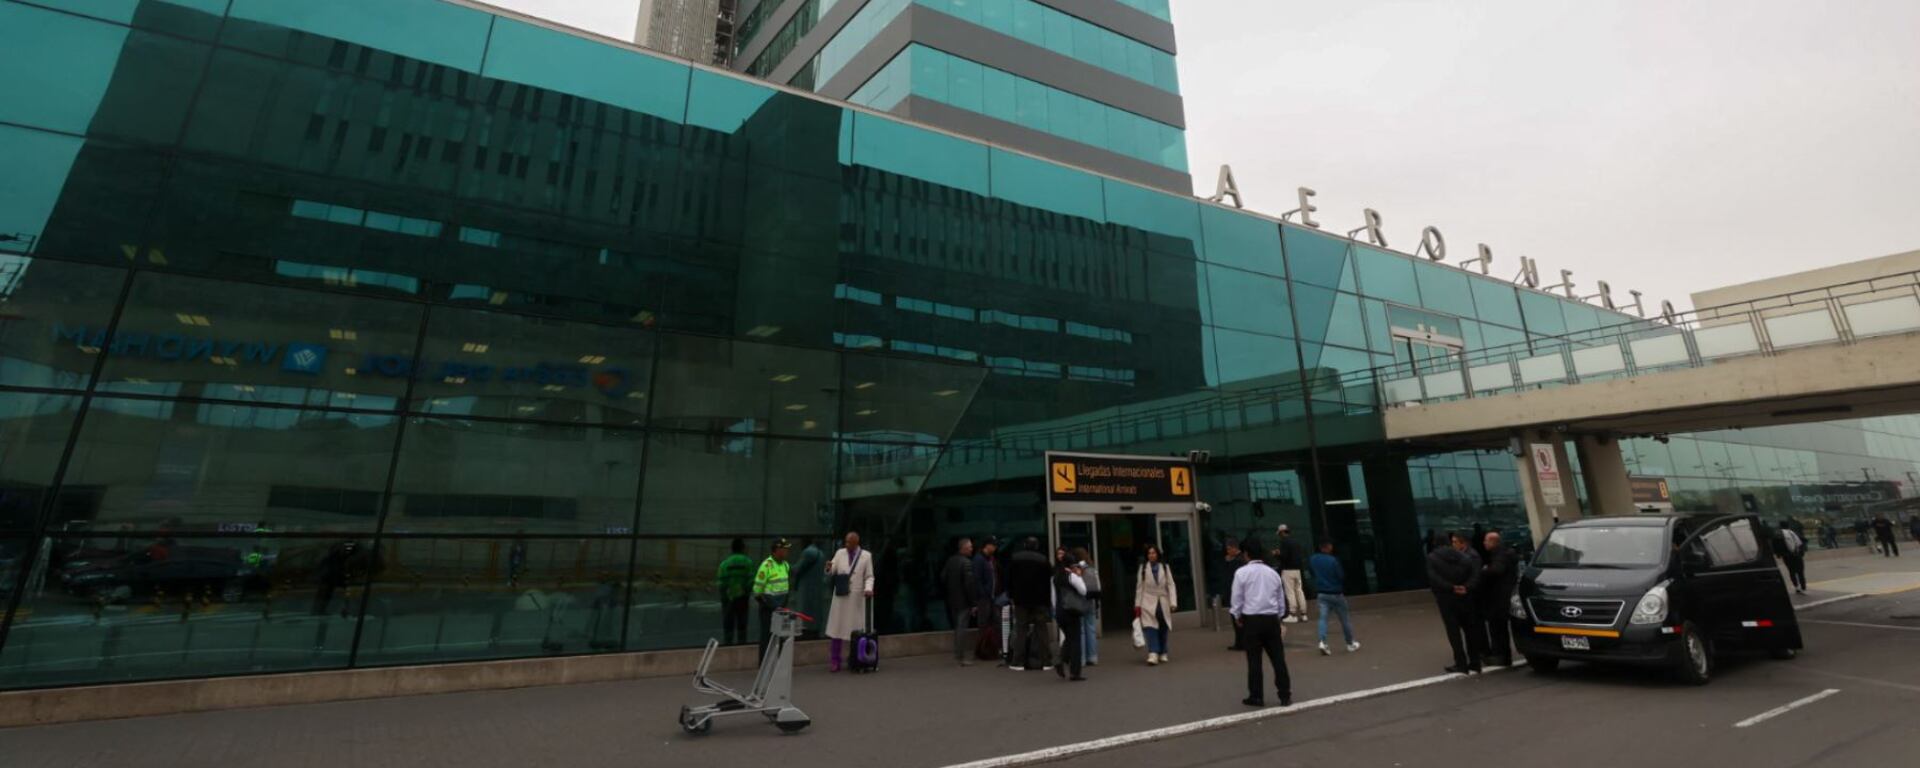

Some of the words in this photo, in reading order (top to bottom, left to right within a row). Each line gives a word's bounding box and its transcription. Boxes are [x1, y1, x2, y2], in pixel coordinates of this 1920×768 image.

[1215, 164, 1676, 325] AEROPUERTO
[1077, 463, 1111, 478] Llegadas
[1112, 465, 1165, 479] Internacionales
[1175, 470, 1185, 491] 4
